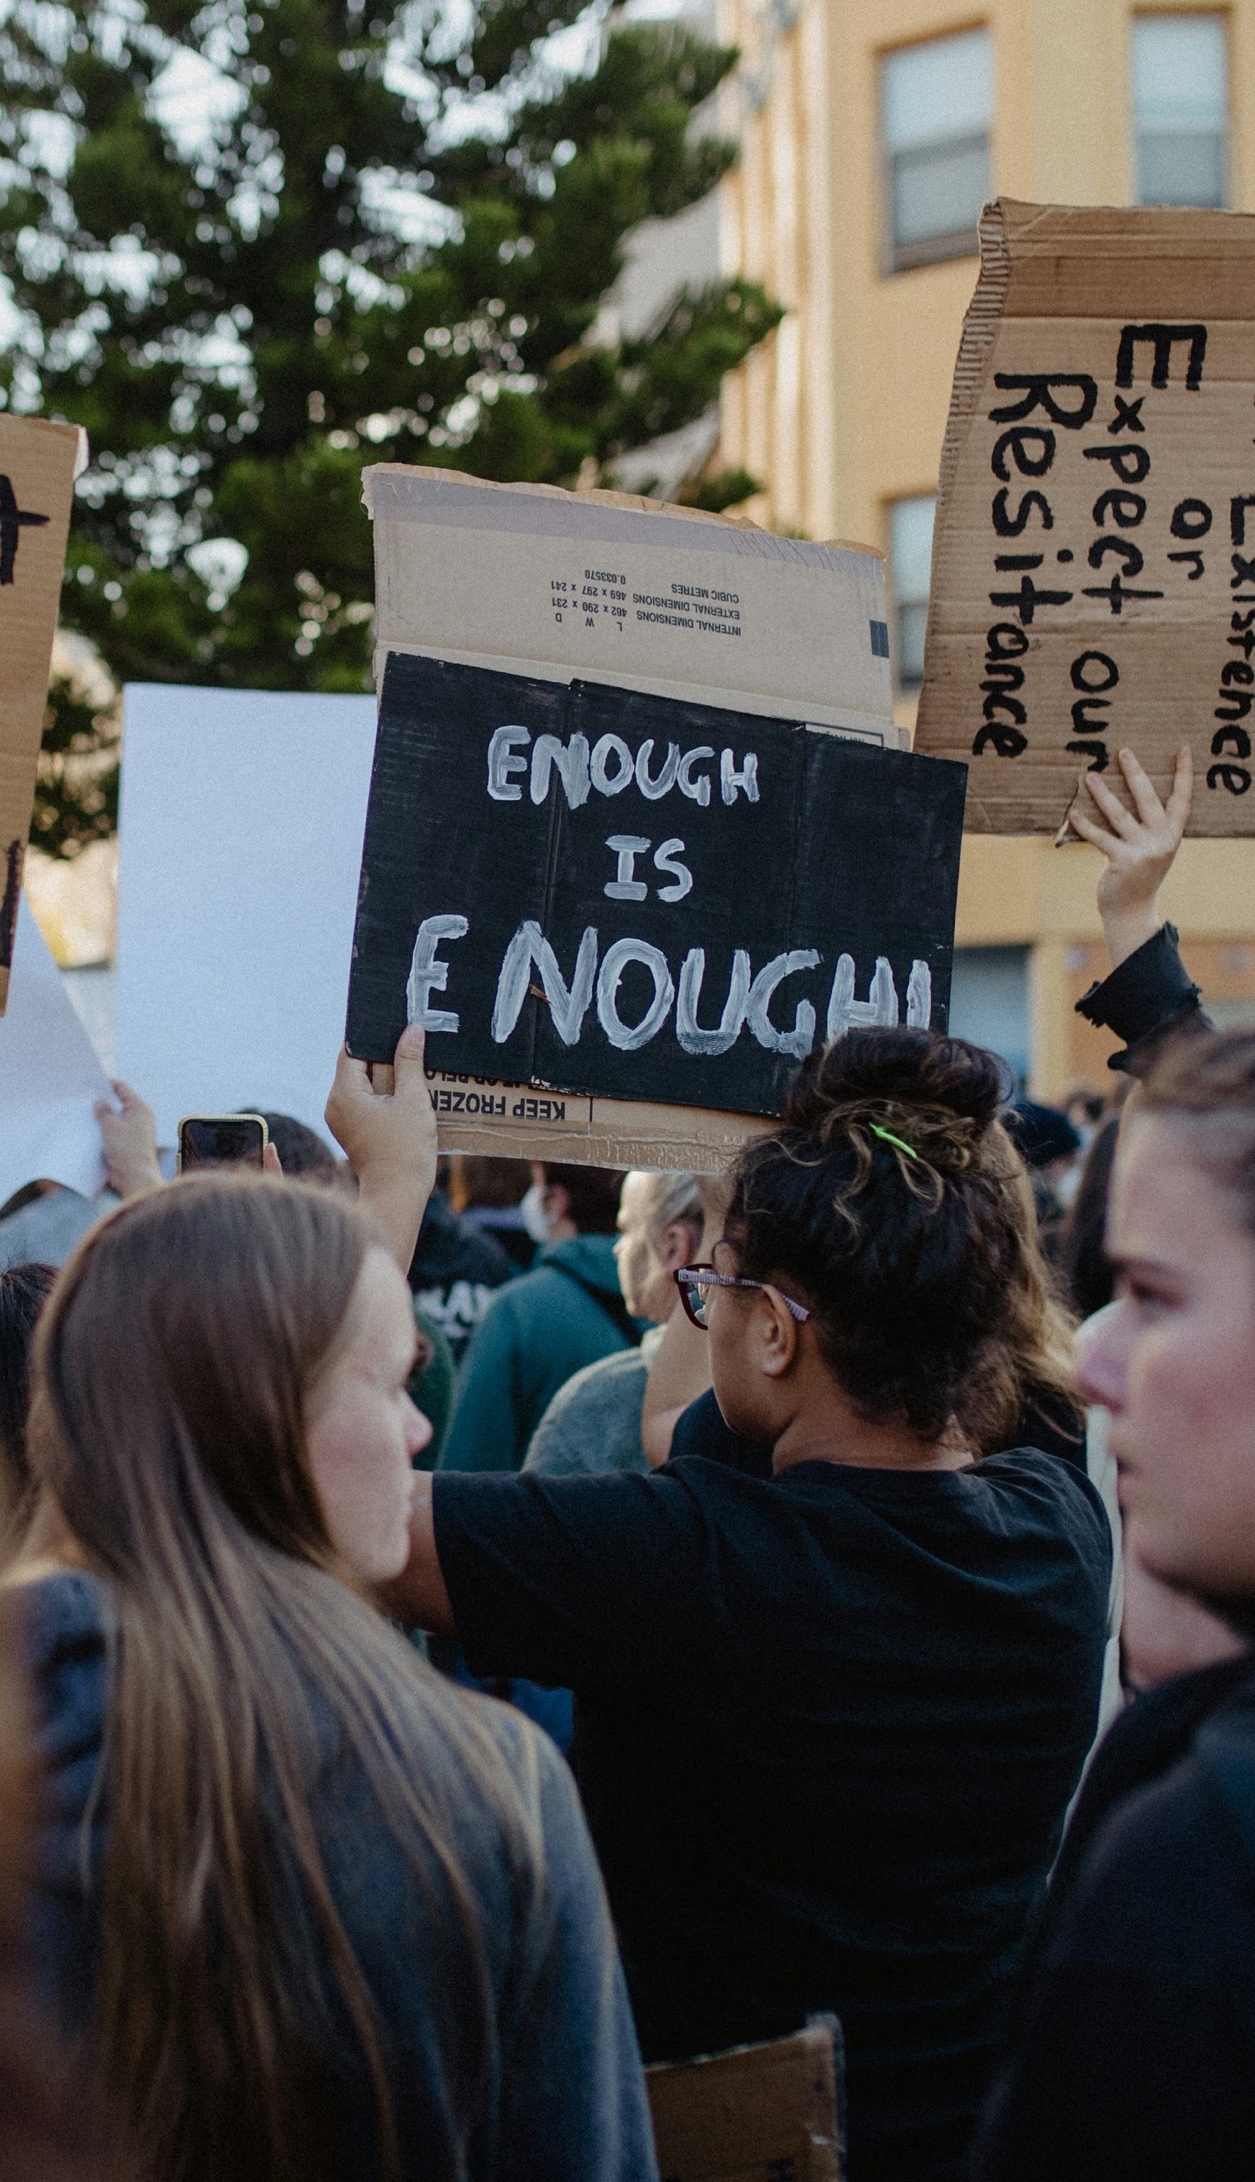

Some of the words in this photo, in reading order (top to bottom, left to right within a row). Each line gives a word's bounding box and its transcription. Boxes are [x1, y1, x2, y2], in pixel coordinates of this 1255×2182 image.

[1082, 324, 1208, 615] Expect
[1168, 498, 1213, 581] or
[972, 373, 1098, 759] Resitance
[584, 569, 626, 585] 0.033570
[551, 580, 567, 592] 241
[581, 585, 598, 597] 297
[671, 583, 709, 598] METRES
[551, 597, 568, 608] 231
[609, 590, 627, 601] 469
[632, 593, 690, 612] DIMENSIONS
[711, 590, 739, 604] CUBIC
[582, 602, 599, 613] 290
[611, 606, 627, 618] 462
[692, 603, 740, 620] EXTERNAL
[555, 612, 563, 623] D
[585, 617, 595, 627] W
[636, 610, 694, 629] DIMENSIONS
[616, 622, 623, 632] L
[696, 619, 741, 636] INTERNAL
[1066, 650, 1120, 774] our
[487, 724, 760, 809] ENOUGH
[604, 834, 693, 902] IS
[512, 1098, 566, 1120] KEEP
